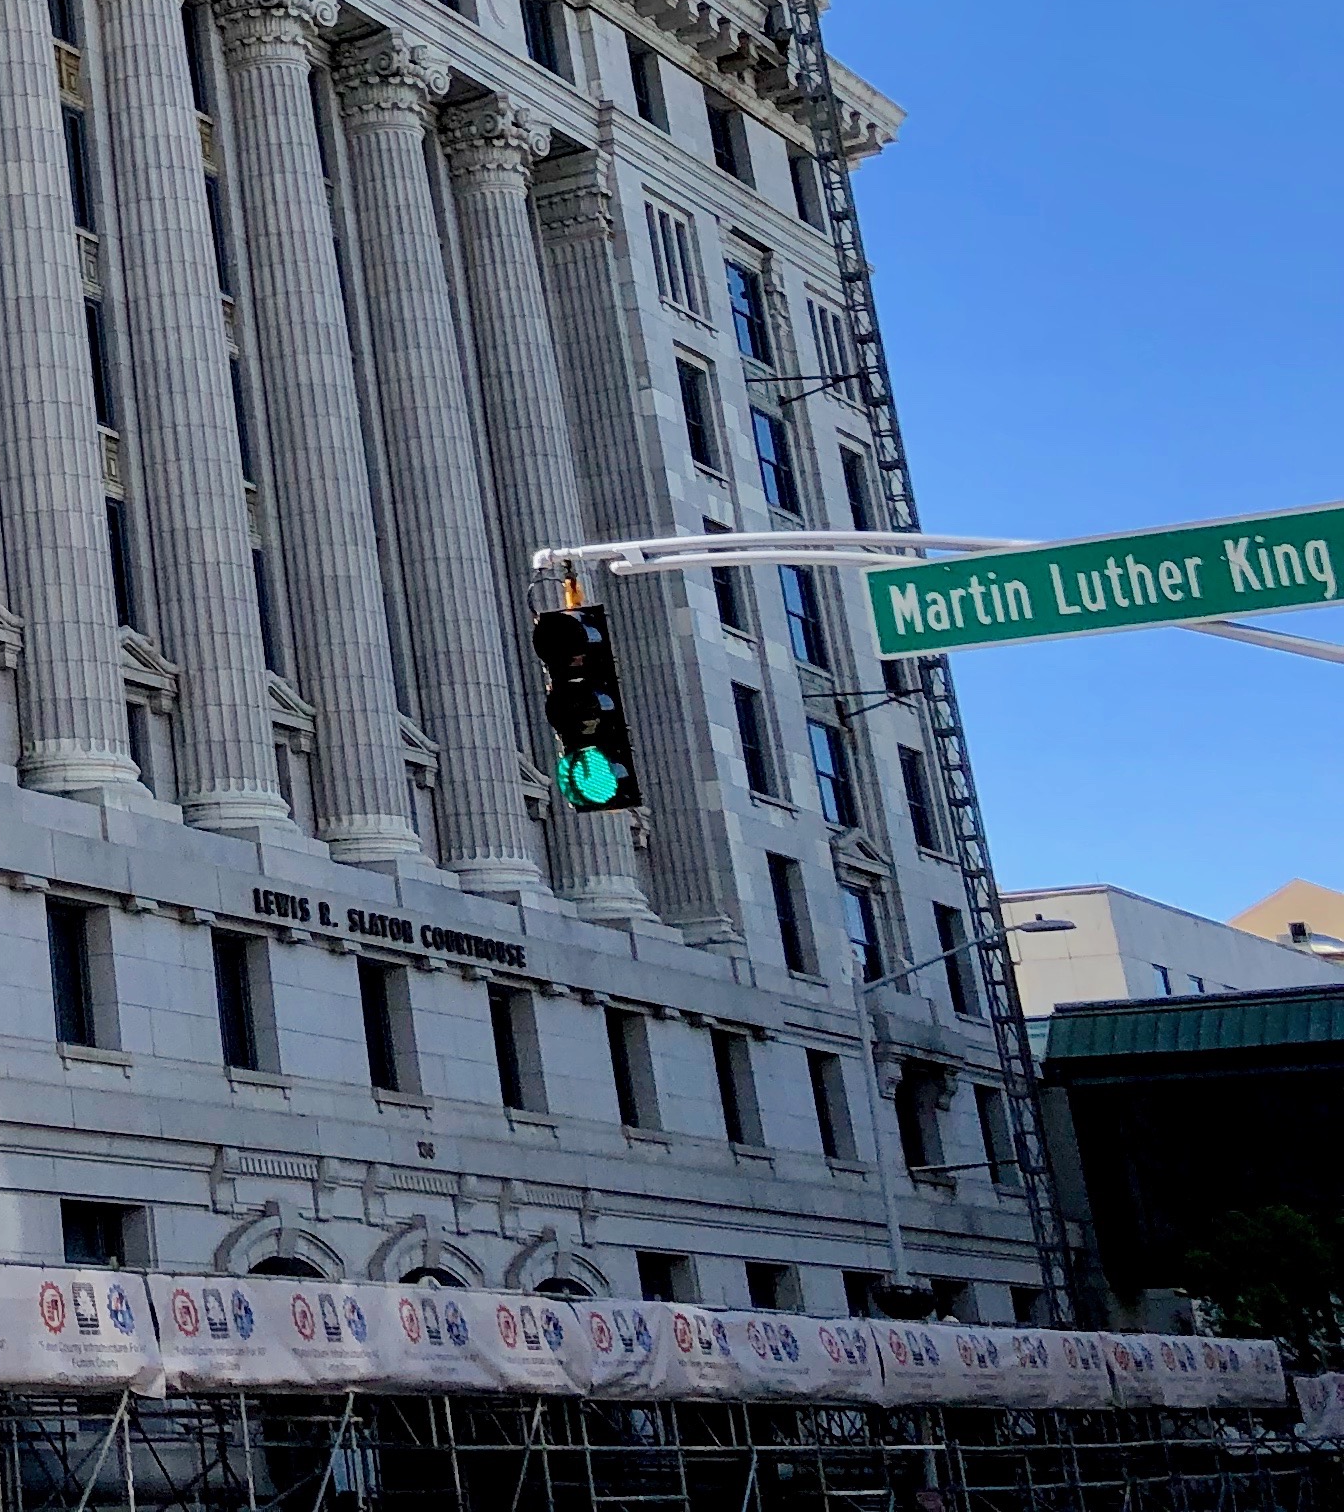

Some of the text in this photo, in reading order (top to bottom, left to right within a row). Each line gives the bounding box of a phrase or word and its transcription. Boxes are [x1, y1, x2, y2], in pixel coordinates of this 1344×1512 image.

[888, 535, 1338, 636] Martin Luther King
[252, 887, 311, 923] LEWIS
